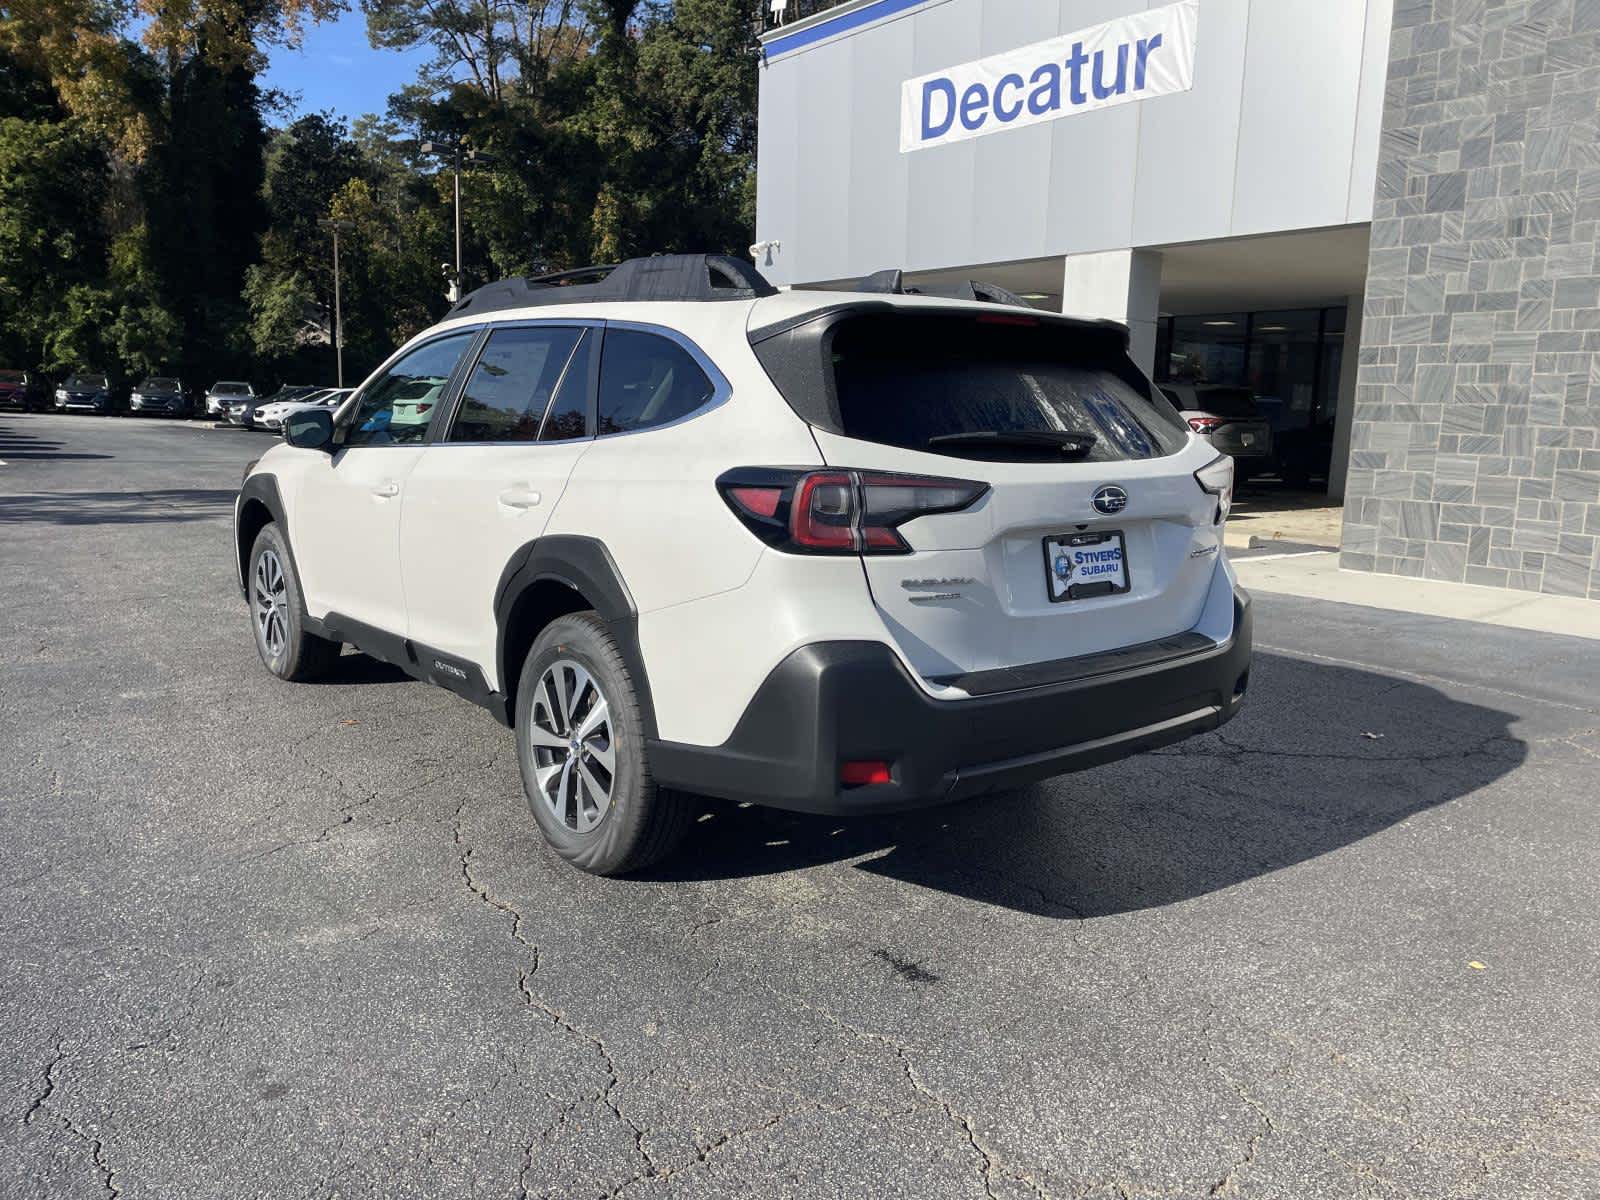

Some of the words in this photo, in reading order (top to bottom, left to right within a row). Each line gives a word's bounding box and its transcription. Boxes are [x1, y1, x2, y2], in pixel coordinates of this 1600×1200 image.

[921, 33, 1162, 140] Decatur
[1074, 547, 1122, 564] STIVERS
[1081, 563, 1119, 576] SUBARU
